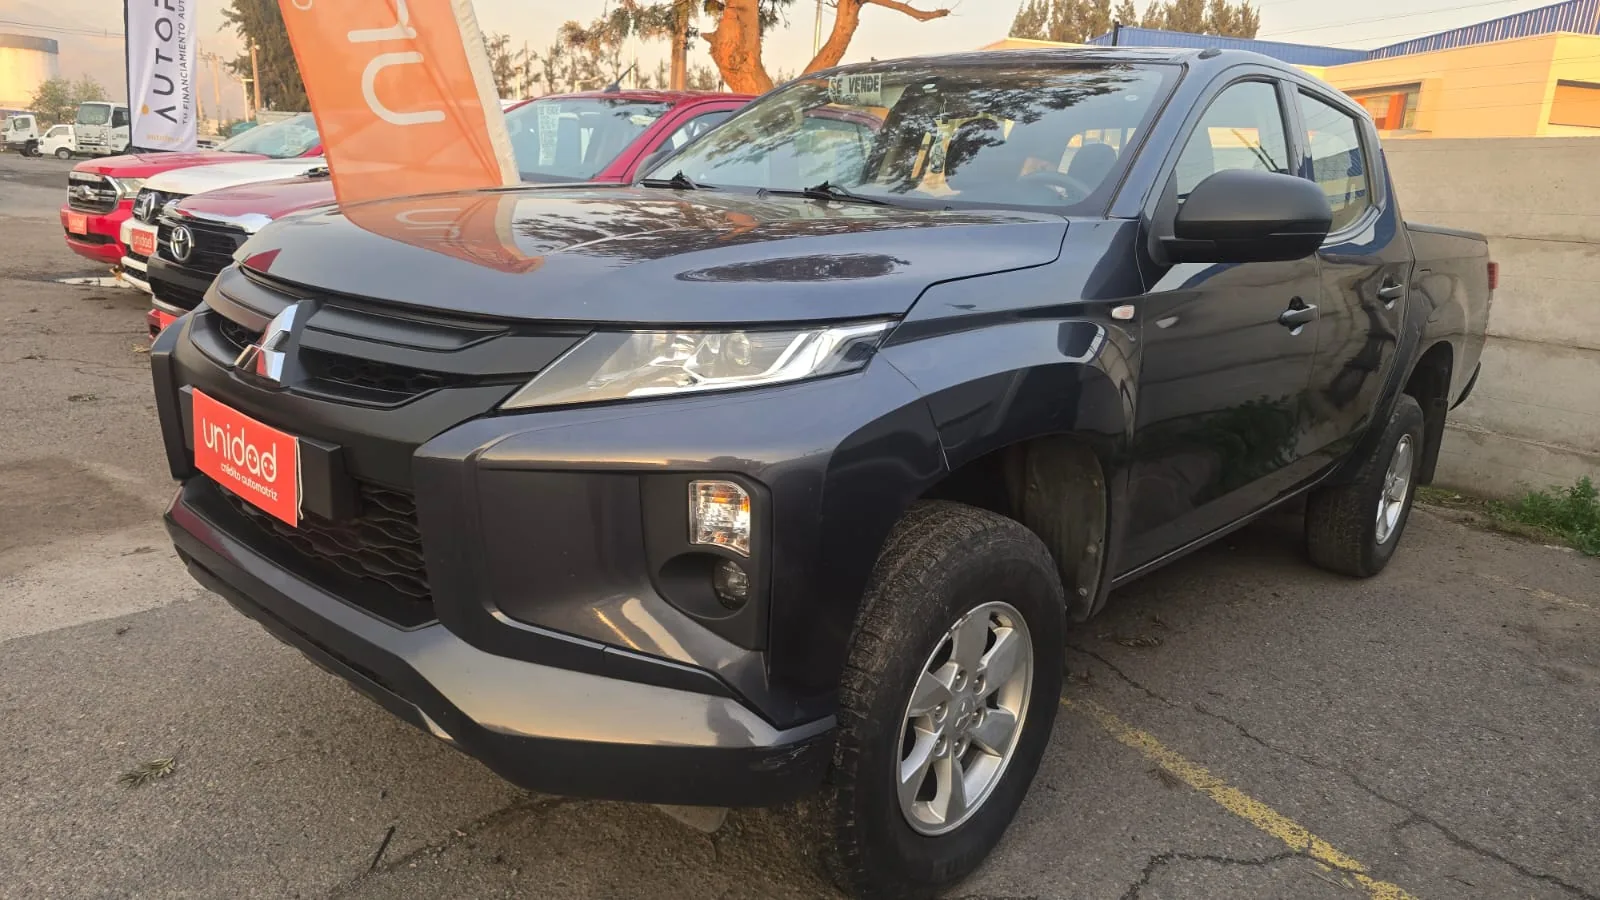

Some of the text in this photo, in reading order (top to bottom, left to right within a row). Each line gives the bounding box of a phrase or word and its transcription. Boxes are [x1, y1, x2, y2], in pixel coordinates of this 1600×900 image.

[178, 22, 190, 110] FINANCIAMIENTO
[848, 75, 880, 94] VENDE
[202, 417, 277, 483] unidad
[241, 476, 278, 502] automotriz
